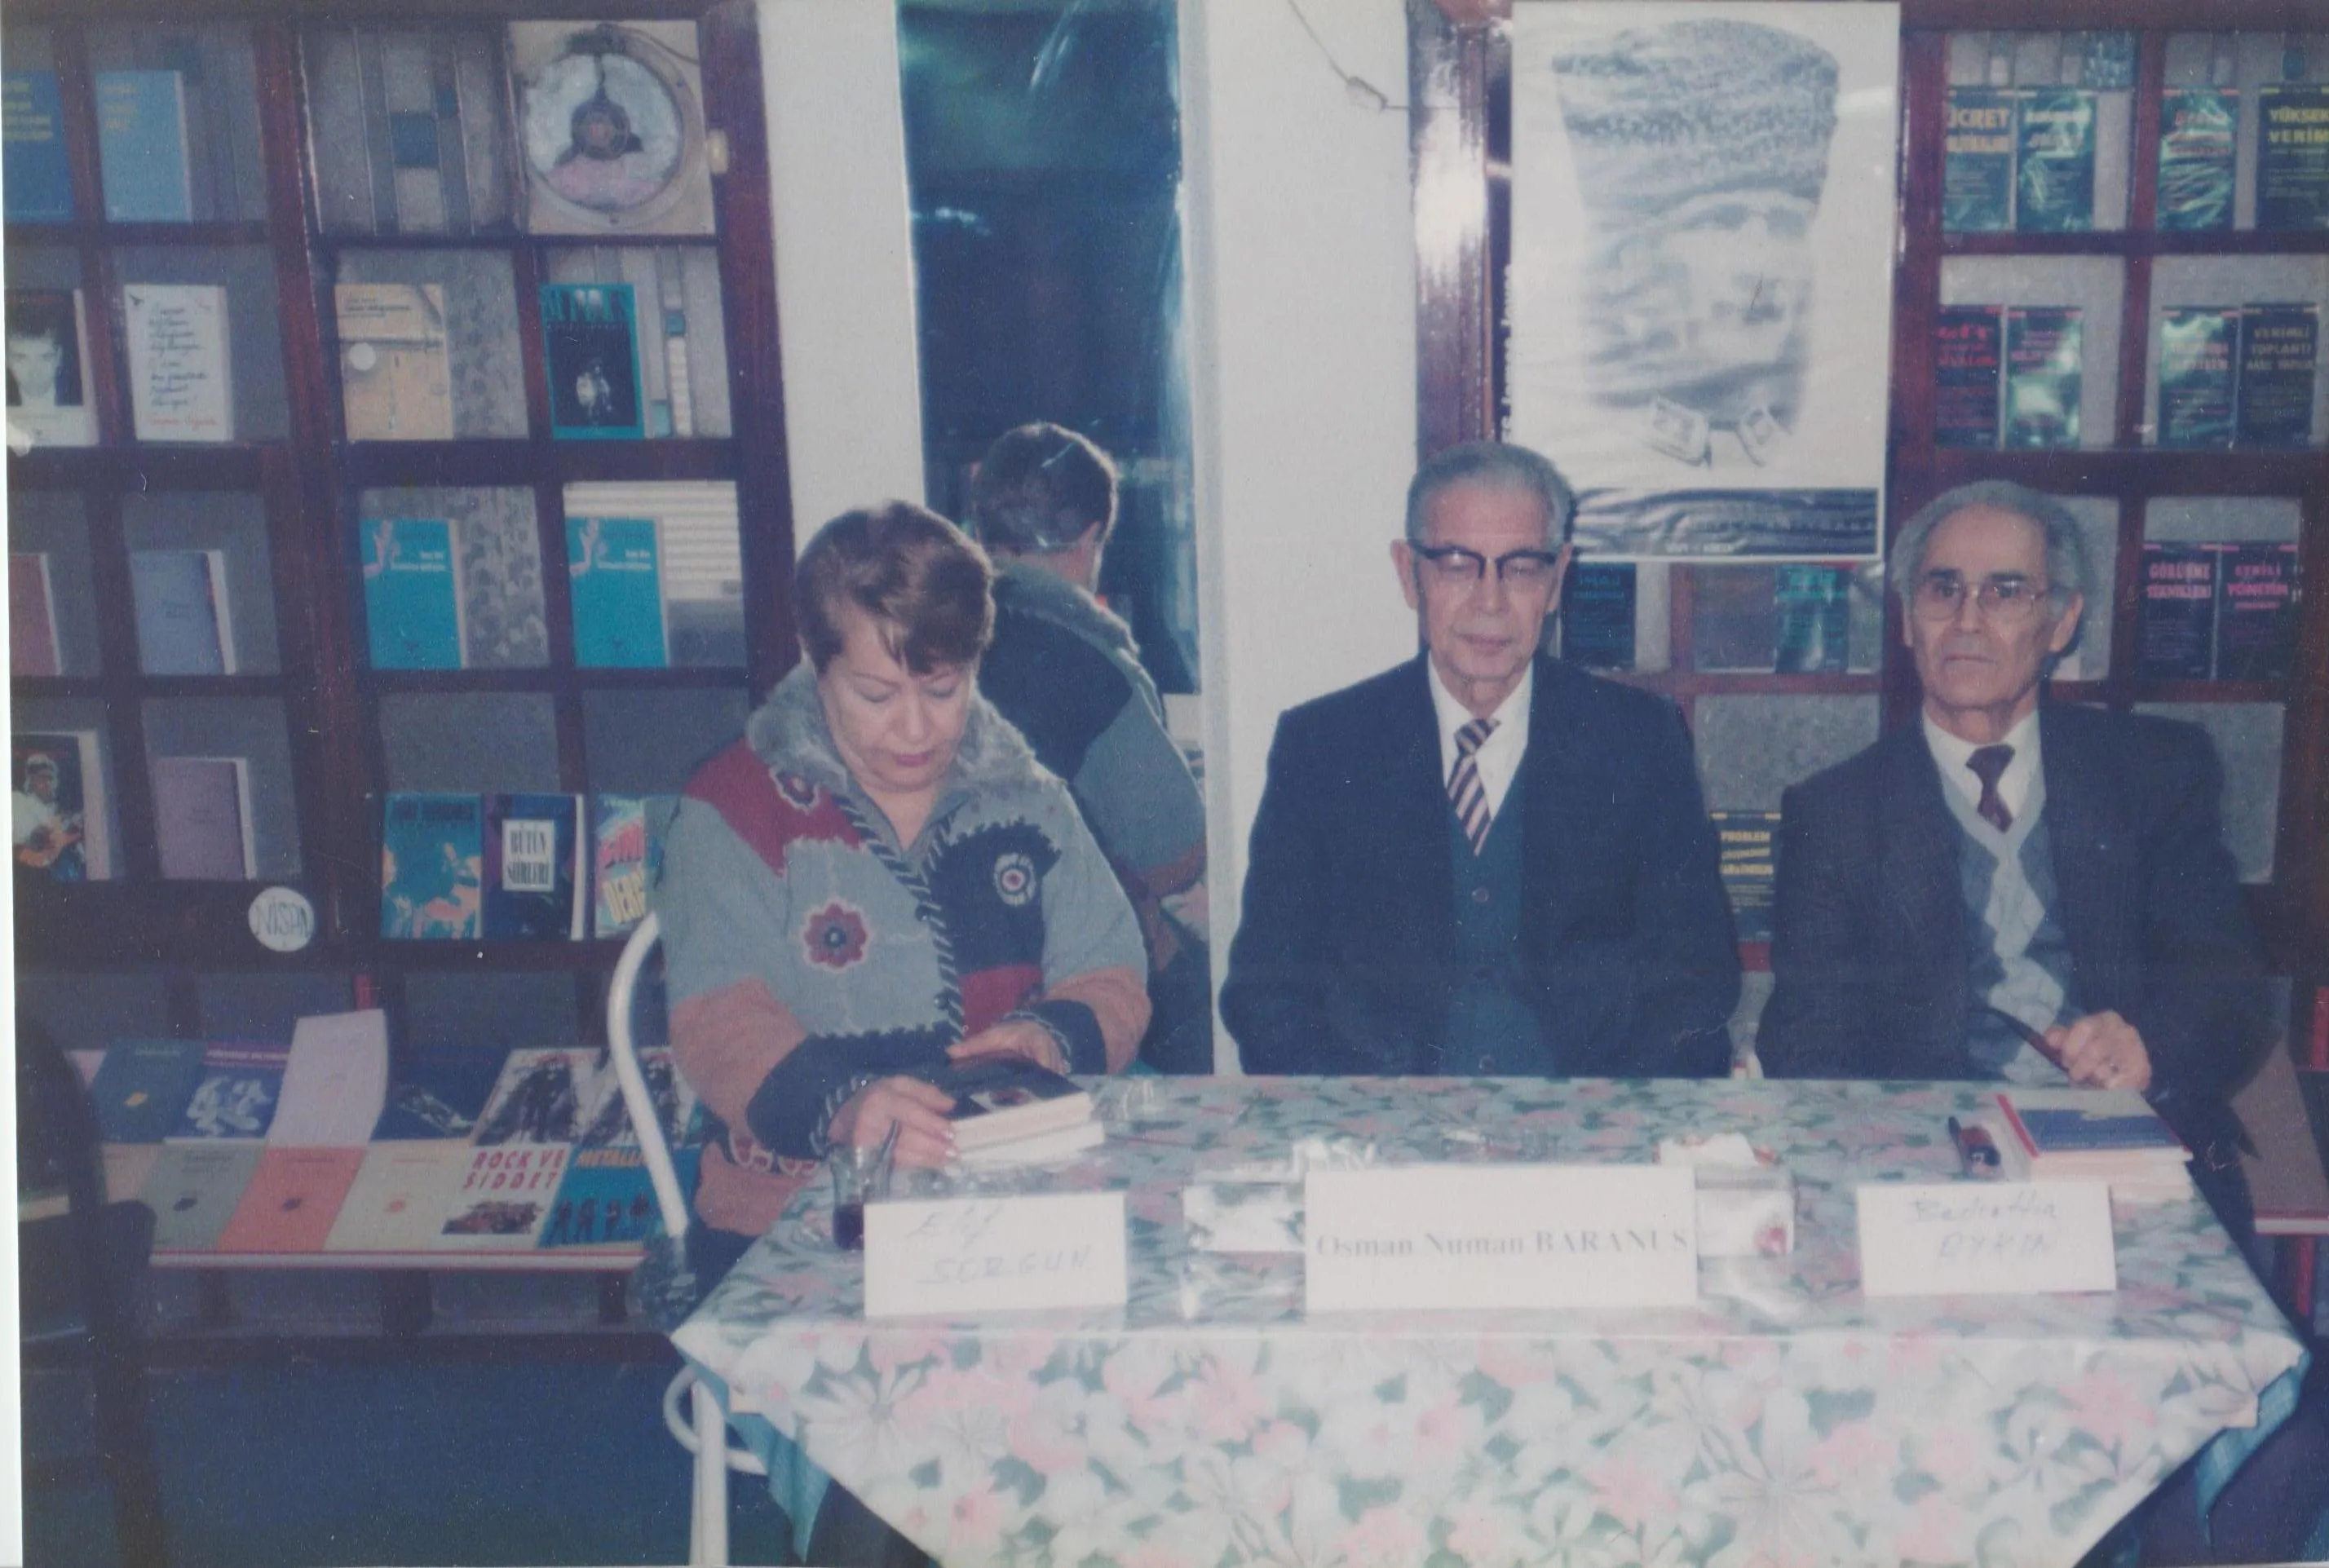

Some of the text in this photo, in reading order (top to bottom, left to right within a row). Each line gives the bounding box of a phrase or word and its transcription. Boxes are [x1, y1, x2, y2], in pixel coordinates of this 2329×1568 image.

[510, 823, 547, 855] BÜTÜN
[471, 1147, 566, 1170] ROCK VE
[1316, 1233, 1413, 1258] Osman
[1425, 1231, 1524, 1257] Numan
